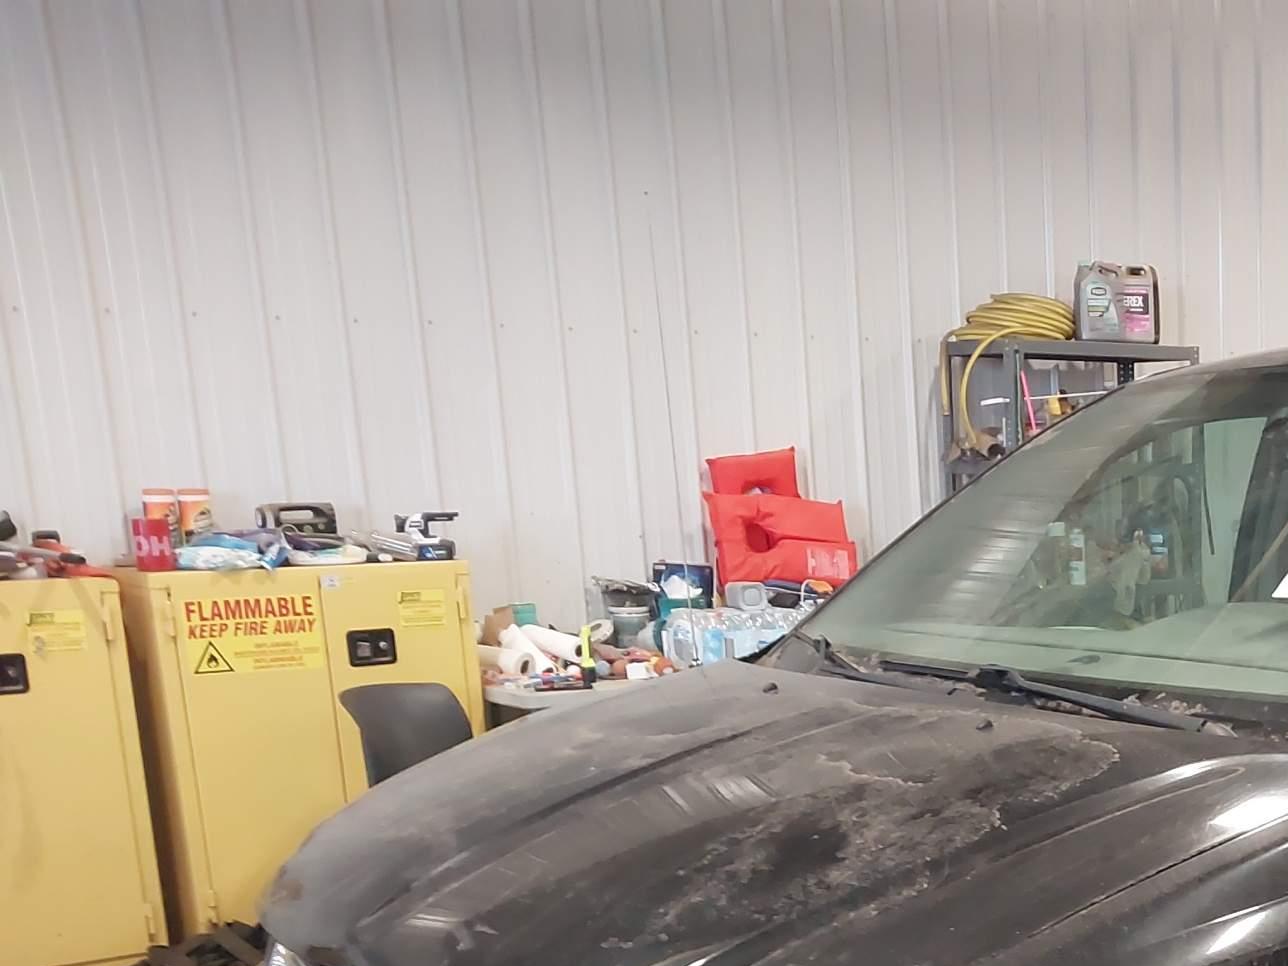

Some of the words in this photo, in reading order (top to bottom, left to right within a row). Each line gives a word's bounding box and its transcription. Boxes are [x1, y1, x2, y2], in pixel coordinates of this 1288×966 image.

[184, 596, 314, 622] FLAMMABLE
[188, 622, 229, 639] KEEP
[233, 620, 268, 637] FIRE
[273, 618, 317, 635] AWAY
